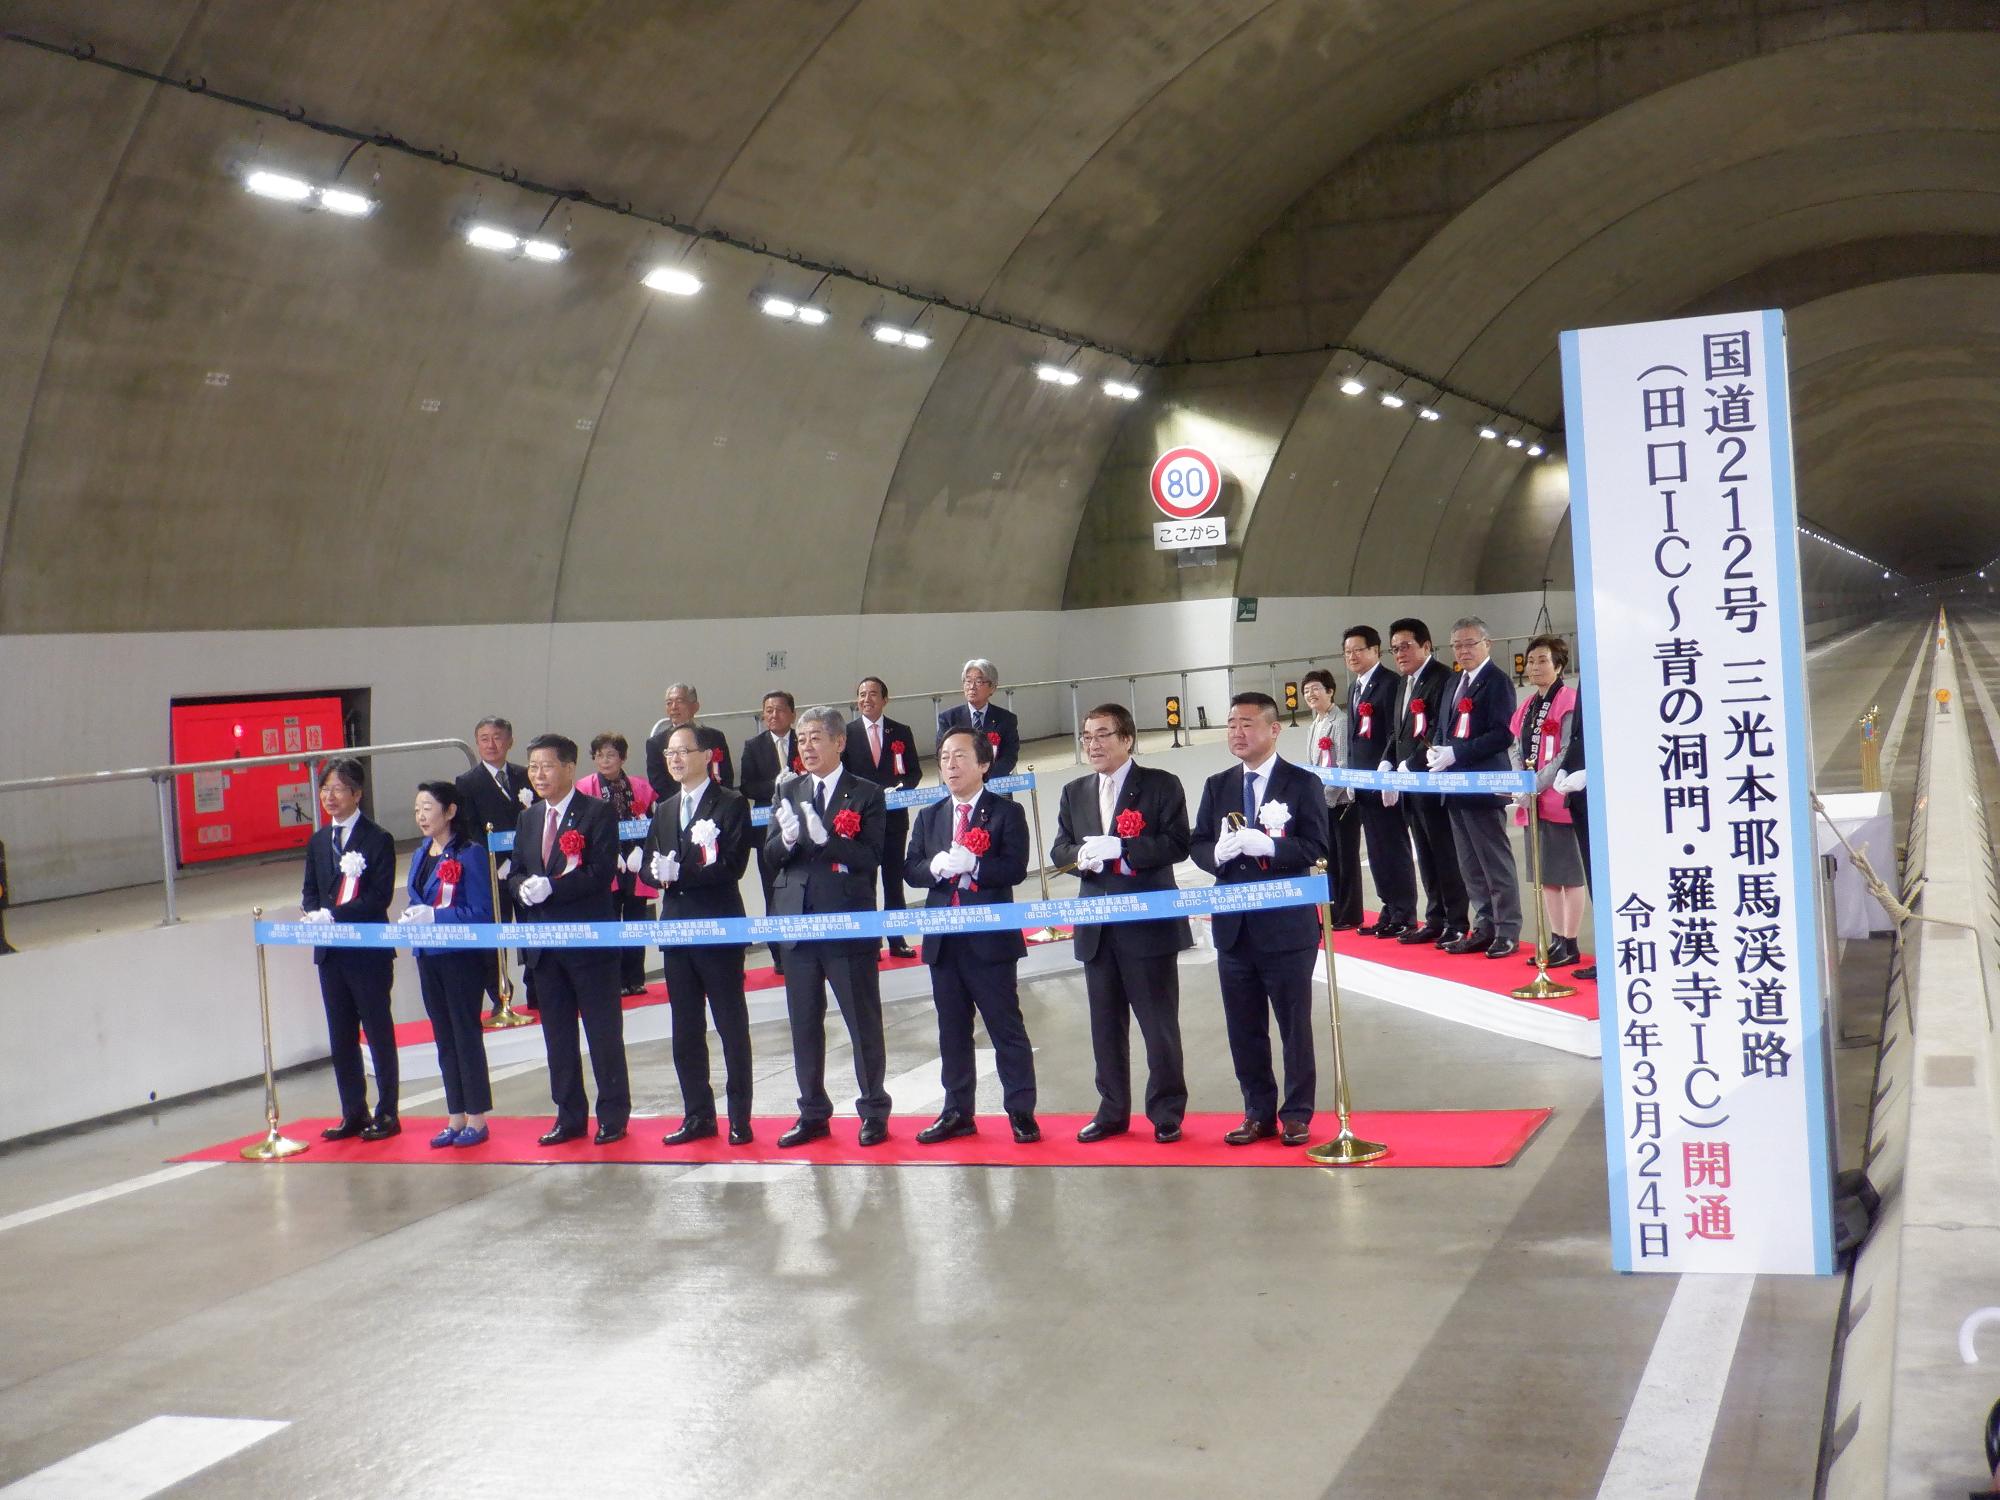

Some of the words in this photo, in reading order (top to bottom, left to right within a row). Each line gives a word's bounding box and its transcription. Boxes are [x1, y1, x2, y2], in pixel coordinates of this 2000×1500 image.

[1159, 525, 1220, 543] ここから
[1167, 467, 1204, 499] 80
[1702, 329, 1767, 634] 国道212号
[1614, 891, 1670, 1258] 令和6年3月24日
